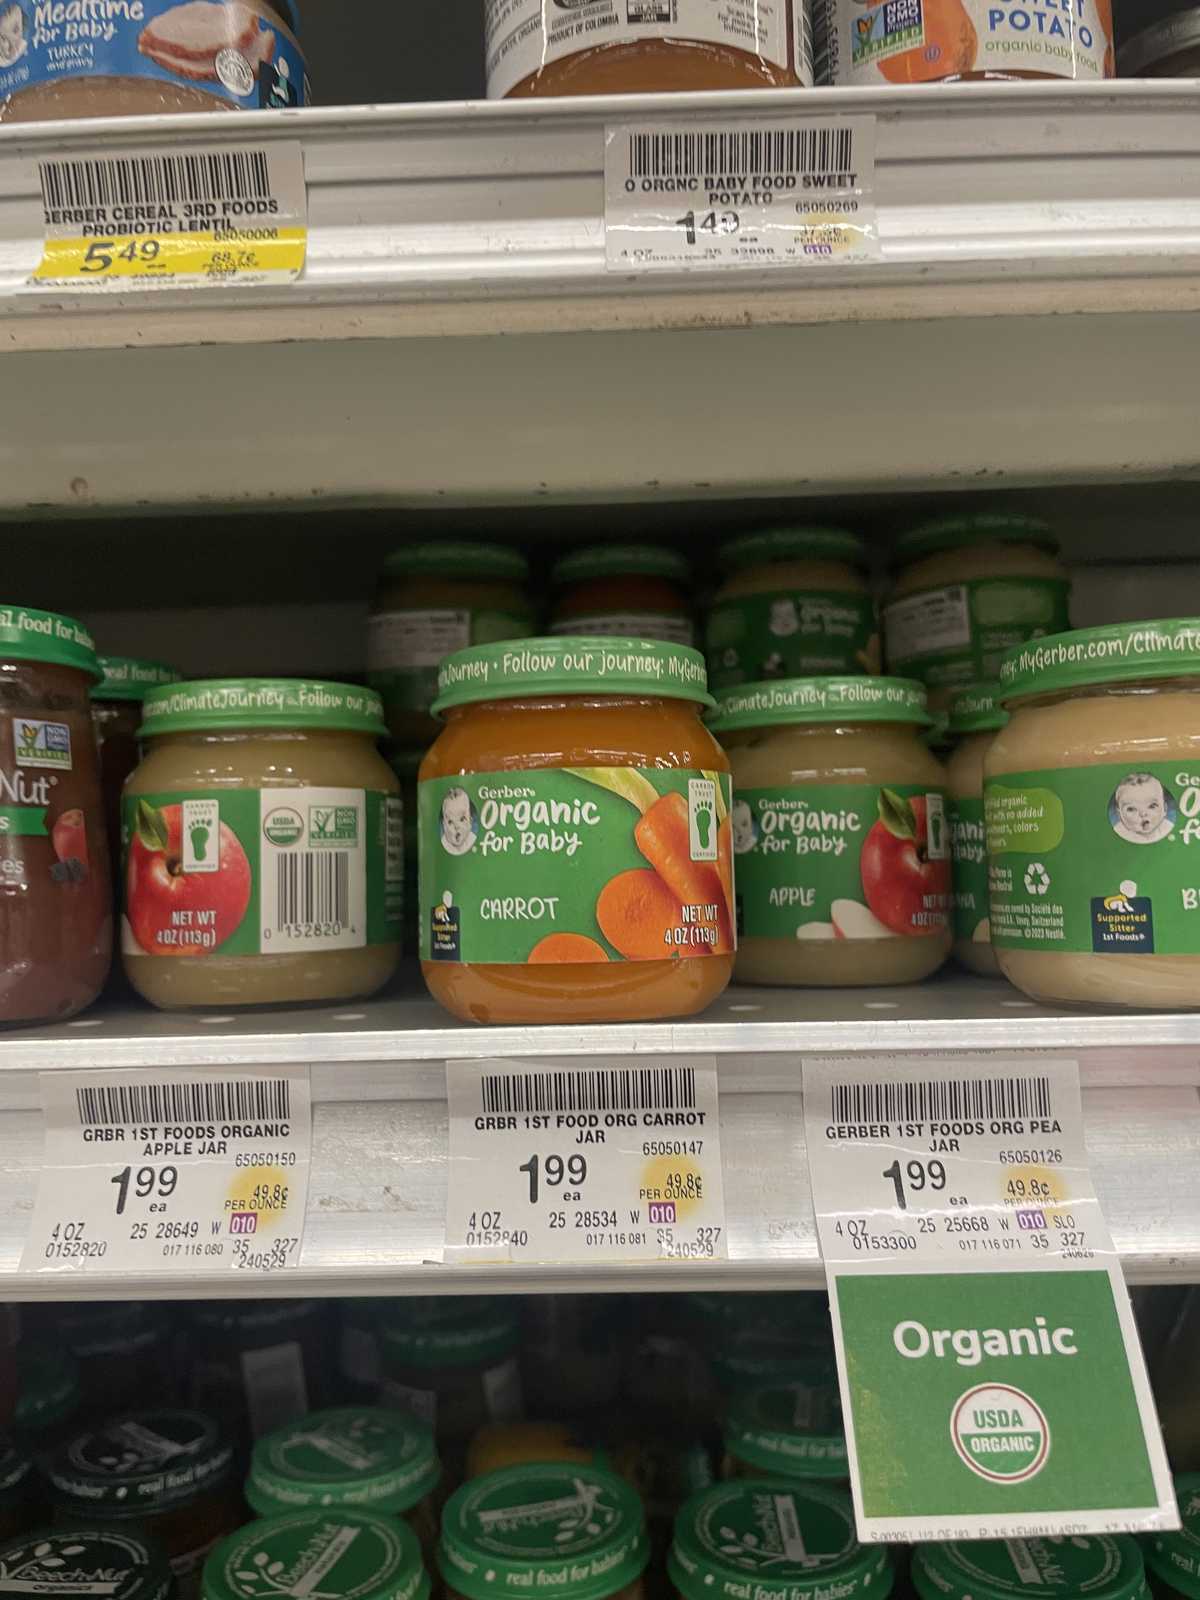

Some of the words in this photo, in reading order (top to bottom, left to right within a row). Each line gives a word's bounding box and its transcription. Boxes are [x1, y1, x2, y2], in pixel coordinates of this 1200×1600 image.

[32, 27, 60, 49] for
[65, 18, 114, 41] Baby
[988, 8, 1093, 49] POTATO
[985, 39, 1042, 54] organic
[625, 181, 635, 192] O
[641, 178, 698, 192] ORGNC
[704, 176, 747, 189] BABY
[753, 175, 796, 188] FOOD
[803, 174, 857, 188] SWEET
[709, 192, 773, 205] POTATO
[795, 200, 858, 214] 65050269
[112, 205, 178, 221] CEREAL
[184, 203, 216, 217] 3RD
[222, 200, 279, 215] FOODS
[82, 221, 174, 238] PROBIOTIC
[179, 218, 235, 233] LENTIL
[18, 611, 52, 635] food
[55, 620, 74, 640] for
[503, 650, 556, 674] Follow
[563, 653, 593, 671] our
[598, 650, 664, 680] journey:
[299, 683, 342, 707] Follow
[839, 684, 883, 702] Follow
[886, 688, 905, 701] our
[480, 799, 600, 831] Organic
[761, 809, 861, 836] Organic
[479, 832, 513, 857] for
[520, 829, 583, 856] Baby
[760, 835, 790, 856] for
[796, 833, 848, 857] Baby
[769, 886, 817, 908] APPLE
[172, 910, 192, 926] NET
[197, 910, 217, 926] WT
[480, 897, 559, 920] CARROT
[682, 904, 702, 924] NET
[704, 903, 719, 922] WT
[1097, 913, 1148, 923] Supported
[285, 922, 341, 938] 152820
[664, 928, 673, 945] 4
[674, 927, 689, 945] OZ
[690, 925, 720, 947] (113g)
[1109, 922, 1136, 932] Sitter
[475, 1116, 518, 1131] GRBR
[524, 1115, 551, 1129] 1ST
[556, 1114, 599, 1128] FOOD
[604, 1113, 638, 1127] ORG
[643, 1112, 707, 1126] CARROT
[826, 1125, 891, 1140] GERBER
[896, 1123, 925, 1138] 1ST
[930, 1122, 985, 1137] FOODS
[990, 1121, 1025, 1135] ORG
[1030, 1120, 1062, 1134] PEA
[83, 1128, 126, 1142] GRBR
[132, 1127, 157, 1141] 1ST
[164, 1125, 216, 1140] FOODS
[221, 1123, 291, 1139] ORGANIC
[576, 1130, 606, 1144] JAR
[143, 1142, 193, 1156] APPLE
[198, 1141, 227, 1155] JAR
[642, 1141, 704, 1155] 65050147
[929, 1138, 960, 1152] JAR
[235, 1152, 297, 1167] 65050150
[999, 1149, 1063, 1164] 65050126
[563, 1190, 582, 1201] ea
[639, 1189, 661, 1200] PER
[665, 1187, 703, 1199] OUNCE
[949, 1195, 968, 1206] ea
[149, 1201, 167, 1213] ea
[224, 1199, 246, 1211] PER
[249, 1197, 288, 1210] OUNCE
[469, 1213, 477, 1229] 4
[481, 1212, 501, 1229] OZ
[549, 1211, 566, 1229] 25
[575, 1210, 618, 1228] 28534
[630, 1211, 640, 1224] W
[650, 1205, 676, 1223] 010
[835, 1221, 843, 1238] 4
[847, 1219, 867, 1238] OZ
[917, 1217, 936, 1233] 25
[944, 1216, 990, 1233] 25668
[999, 1218, 1010, 1231] W
[1018, 1213, 1046, 1230] 010
[1053, 1215, 1076, 1230] SLO
[52, 1224, 61, 1241] 4
[64, 1223, 86, 1241] OZ
[130, 1223, 148, 1240] 25
[155, 1221, 199, 1239] 28649
[211, 1221, 222, 1235] W
[230, 1215, 256, 1235] 010
[586, 1233, 605, 1246] 017
[608, 1233, 626, 1245] 116
[628, 1232, 647, 1245] 081
[696, 1227, 721, 1243] 327
[45, 1240, 107, 1258] 0152820
[163, 1244, 183, 1257] 017
[184, 1243, 203, 1256] 116
[233, 1239, 249, 1254] 35
[272, 1237, 299, 1254] 327
[852, 1235, 917, 1251] 0153300
[959, 1239, 978, 1251] 017
[981, 1239, 1001, 1250] 116
[1002, 1238, 1022, 1250] 071
[1030, 1234, 1049, 1249] 35
[1060, 1231, 1086, 1247] 327
[238, 1252, 287, 1270] 240529
[893, 1317, 1078, 1366] Organic
[973, 1409, 1024, 1429] USDA
[970, 1434, 1035, 1453] ORGANIC
[507, 1569, 534, 1587] real
[537, 1568, 568, 1586] food
[570, 1564, 589, 1582] for
[724, 1580, 751, 1599] real
[753, 1586, 787, 1600] food
[790, 1586, 812, 1600] for
